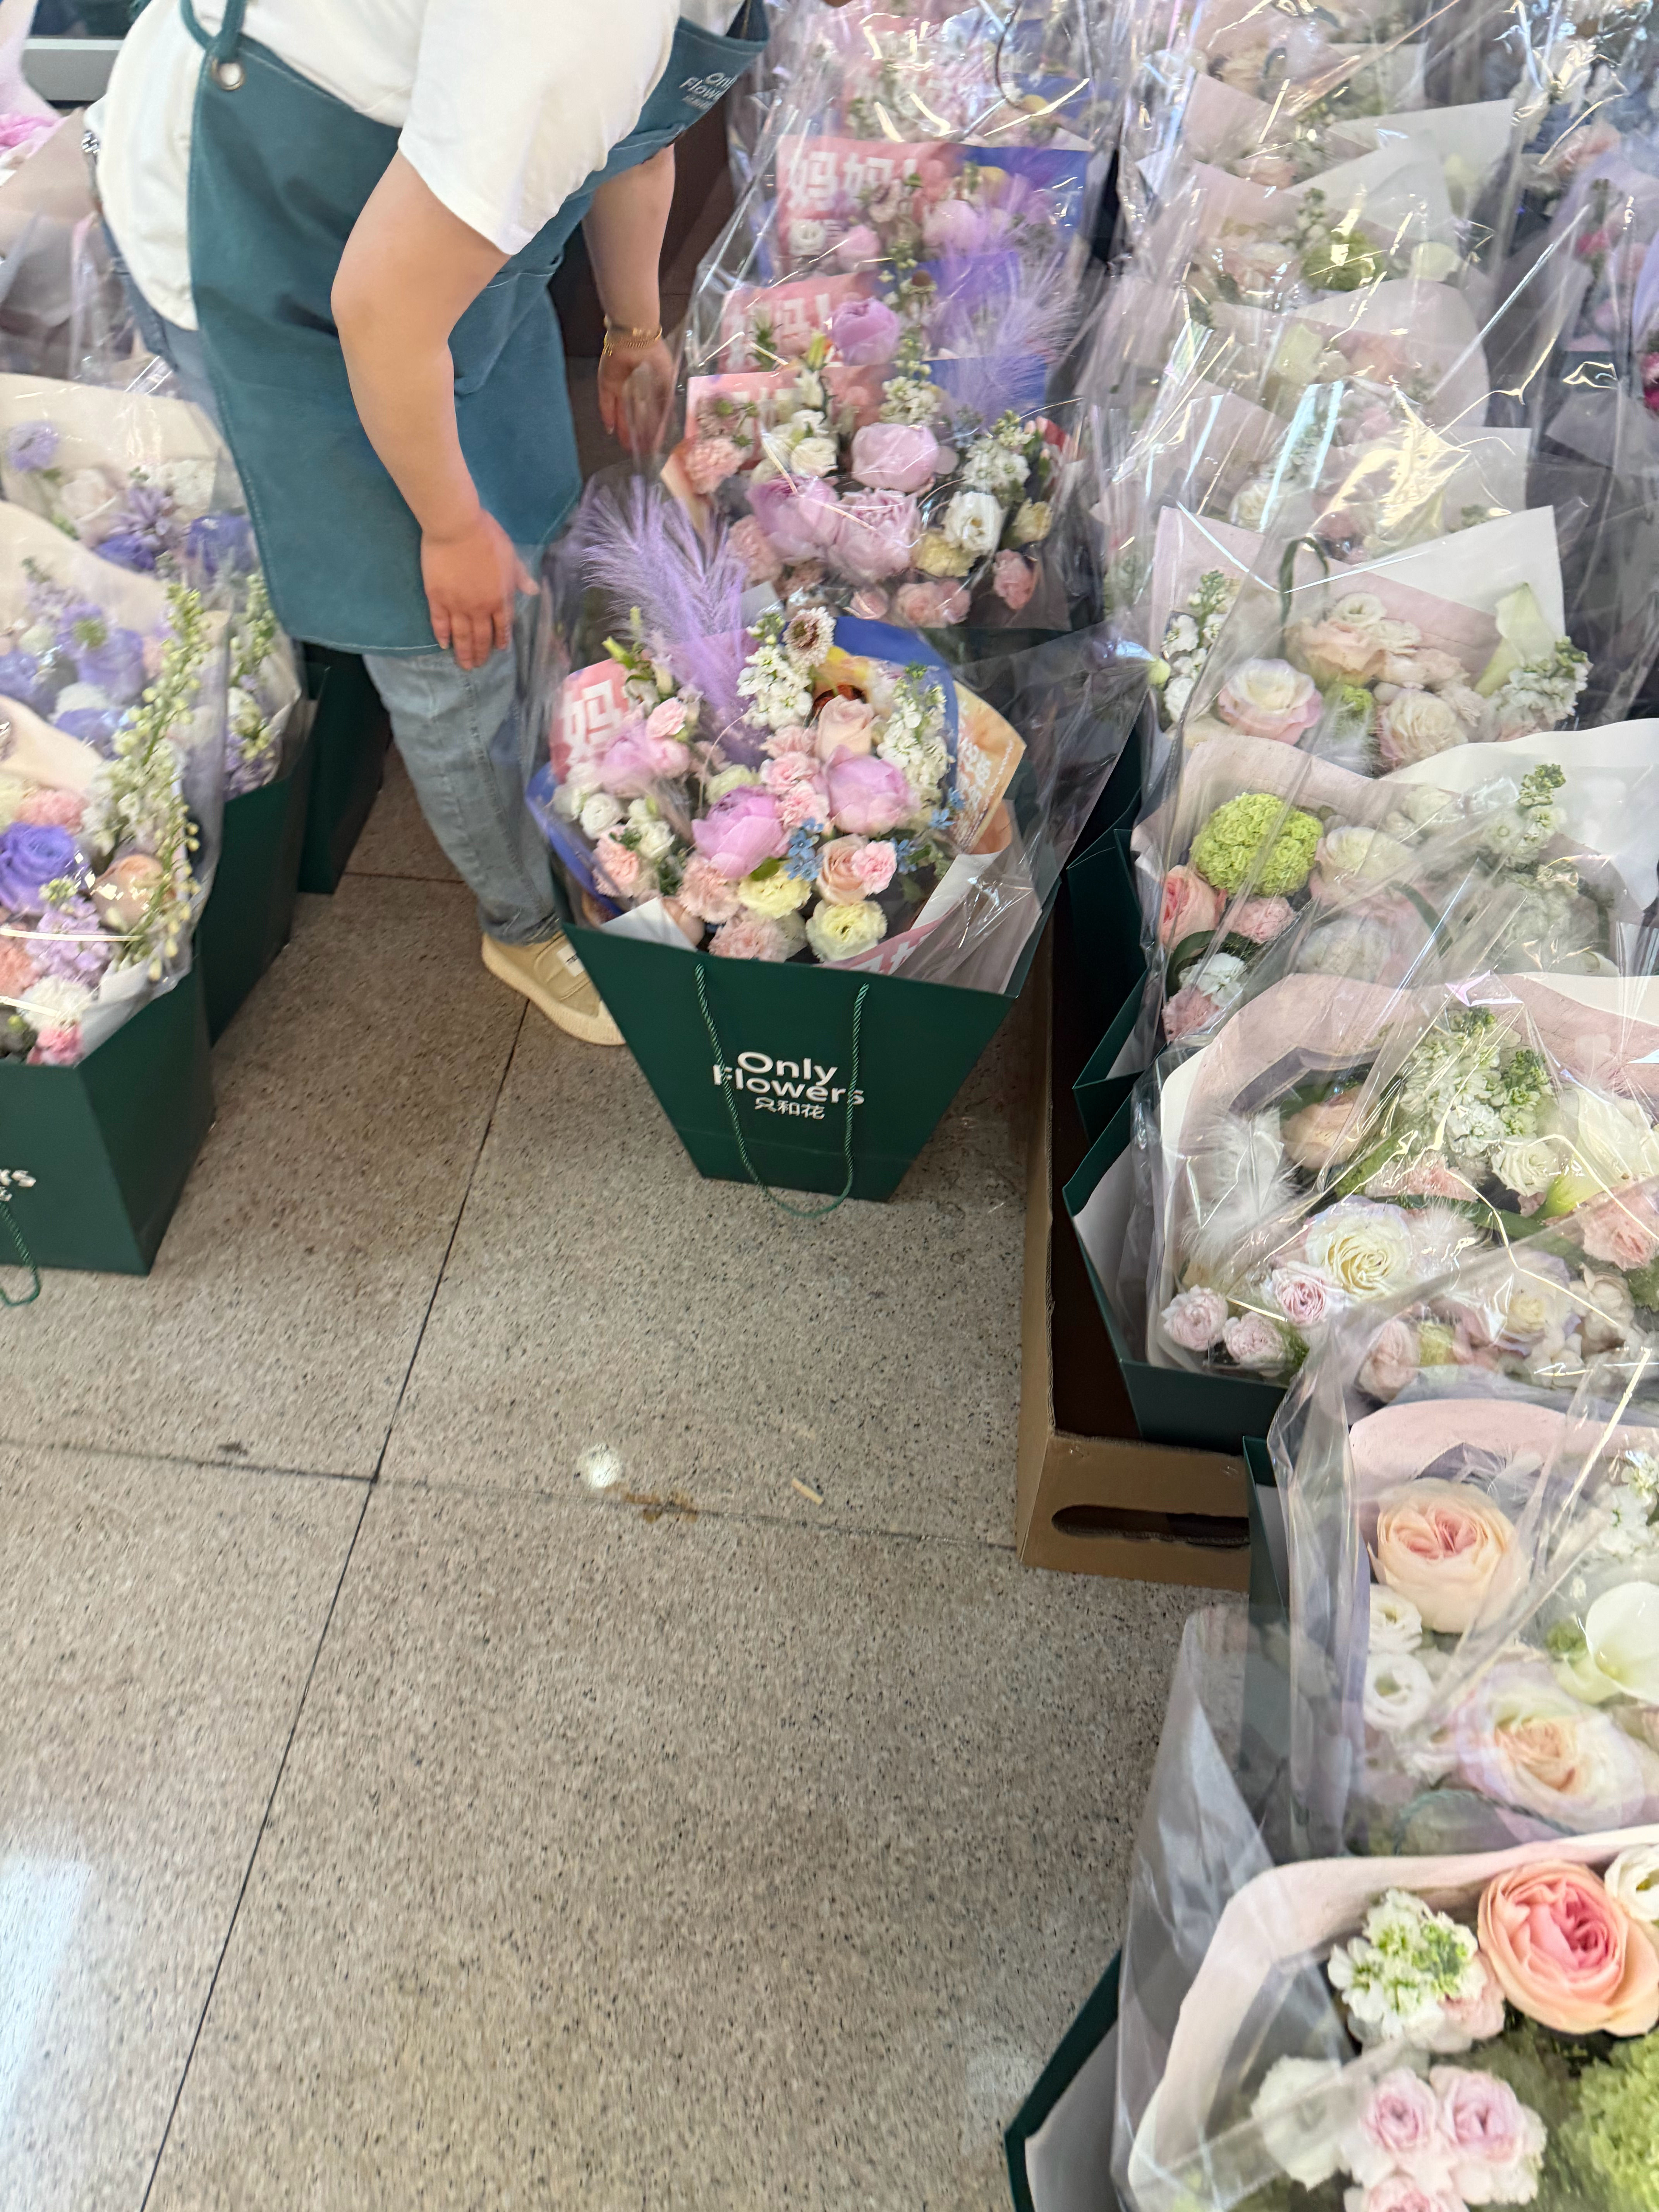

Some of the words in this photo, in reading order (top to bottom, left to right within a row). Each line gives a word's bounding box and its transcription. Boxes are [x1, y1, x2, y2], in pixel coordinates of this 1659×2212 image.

[713, 1064, 865, 1105] Flowers
[737, 1051, 838, 1086] Only
[754, 1097, 825, 1120] 只和花
